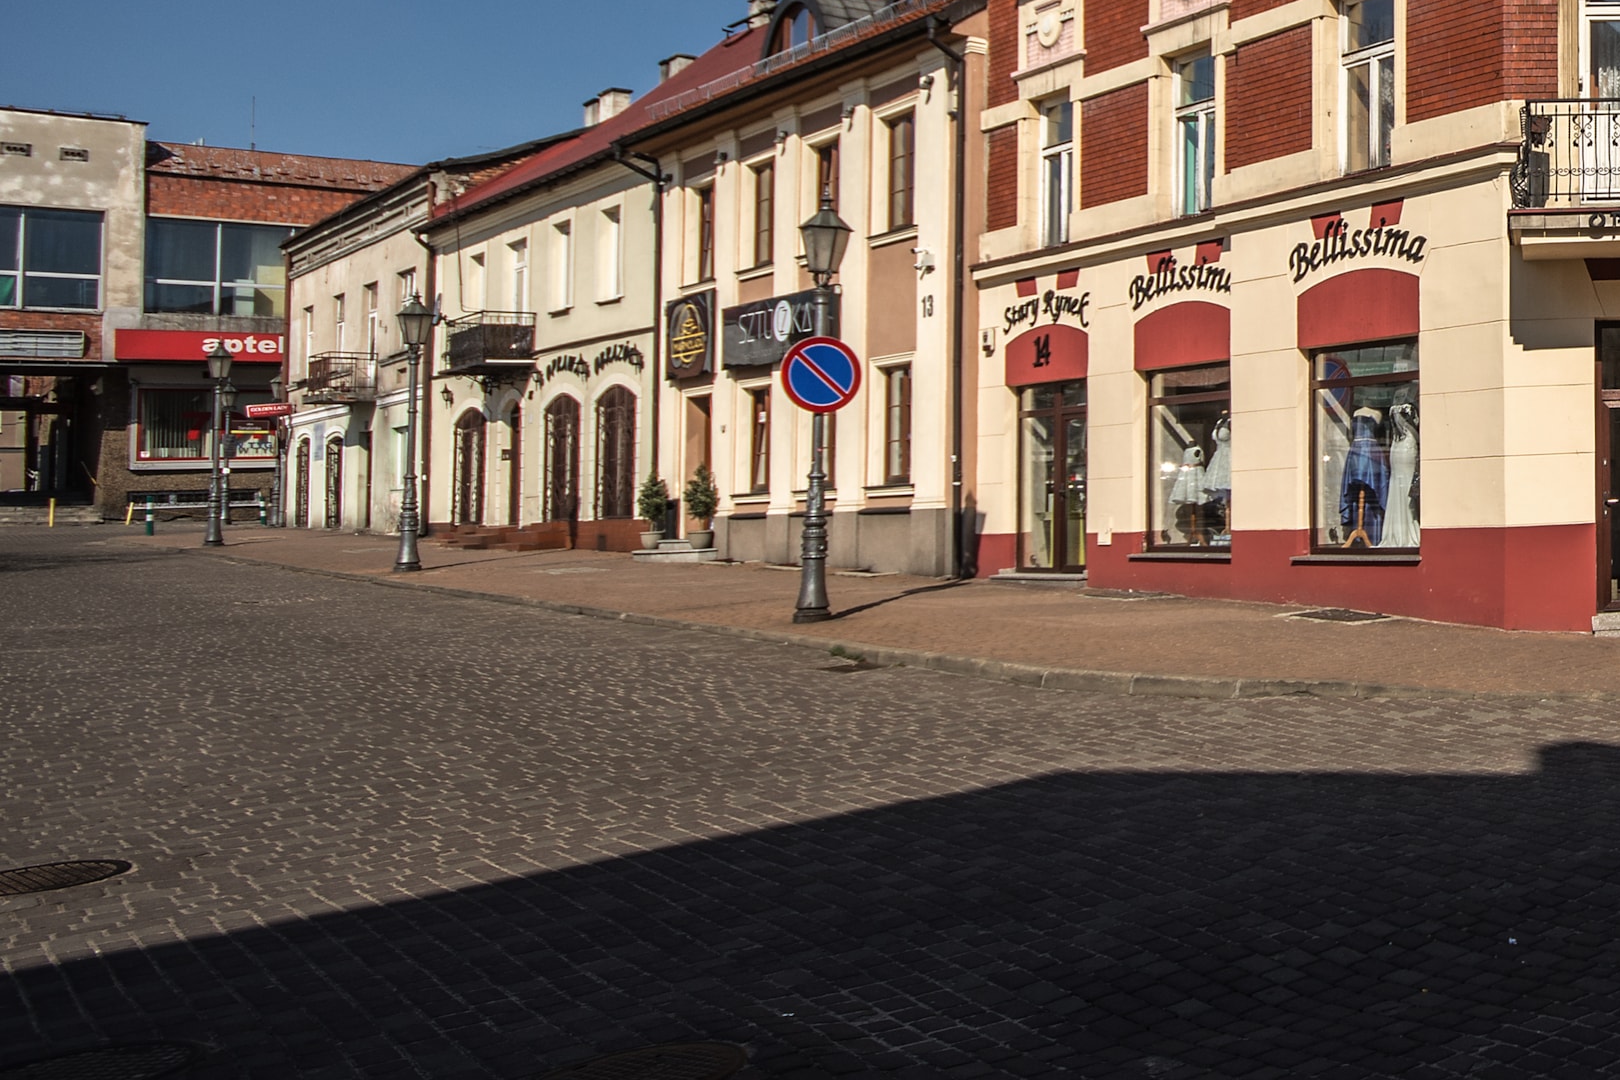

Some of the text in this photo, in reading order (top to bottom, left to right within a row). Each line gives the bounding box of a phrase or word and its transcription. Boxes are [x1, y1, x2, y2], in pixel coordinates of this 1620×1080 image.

[1289, 217, 1428, 285] Bellissima
[921, 294, 934, 318] 13
[1003, 289, 1090, 336] Stary Rynek
[1032, 333, 1052, 369] 14
